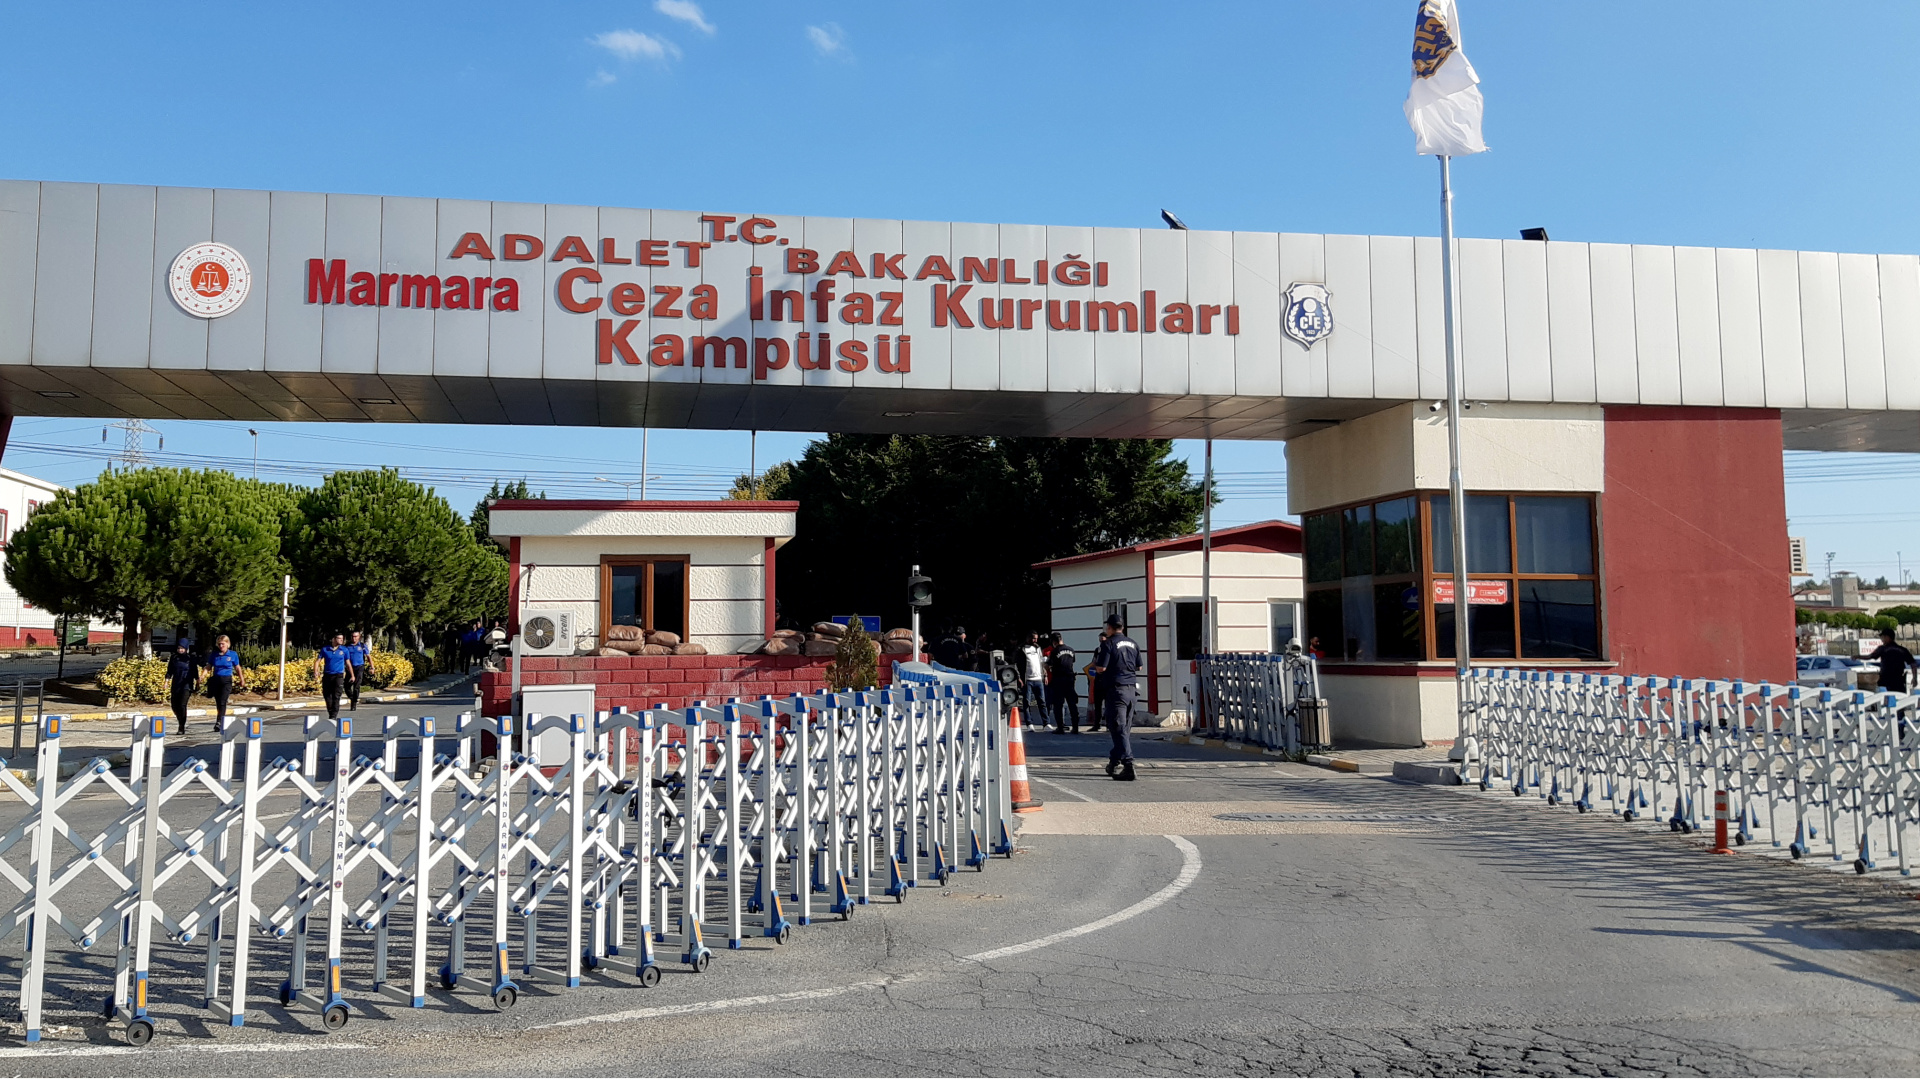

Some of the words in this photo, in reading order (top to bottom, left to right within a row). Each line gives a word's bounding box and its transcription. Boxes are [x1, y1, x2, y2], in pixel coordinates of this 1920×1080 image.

[452, 232, 712, 267] ADALET
[787, 247, 1109, 286] BAKANLIĞI
[701, 216, 789, 245] T.C.
[308, 259, 519, 311] Marmara
[558, 267, 720, 320] Ceza
[750, 267, 904, 326] İnfaz
[934, 283, 1240, 335] Kurumları
[598, 319, 911, 380] Kampüsü
[335, 786, 346, 871] JANDARMA
[500, 780, 508, 860] JANDARMA
